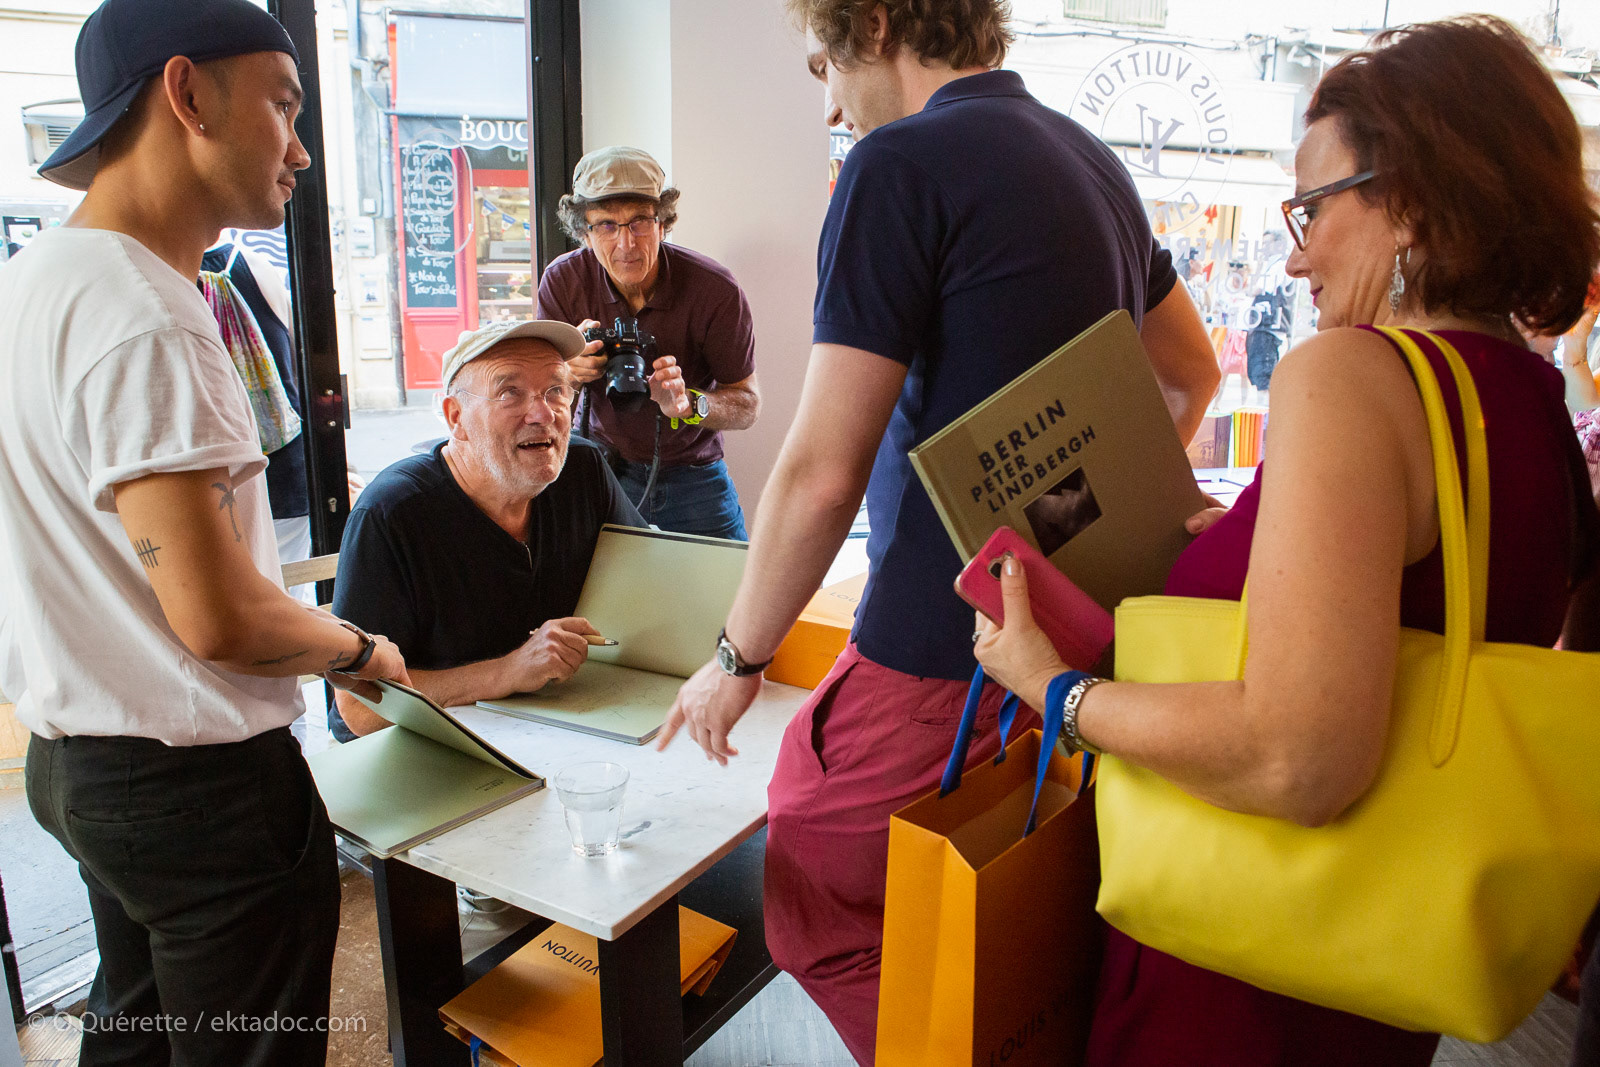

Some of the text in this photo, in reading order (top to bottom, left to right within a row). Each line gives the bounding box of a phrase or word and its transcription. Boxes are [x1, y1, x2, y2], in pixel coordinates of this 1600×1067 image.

[459, 120, 528, 142] BOUC
[977, 399, 1066, 473] BERLIN
[970, 454, 1029, 502] PETER
[987, 425, 1097, 513] LINDBERGH
[830, 591, 860, 603] LOU
[541, 940, 600, 976] VUITTON
